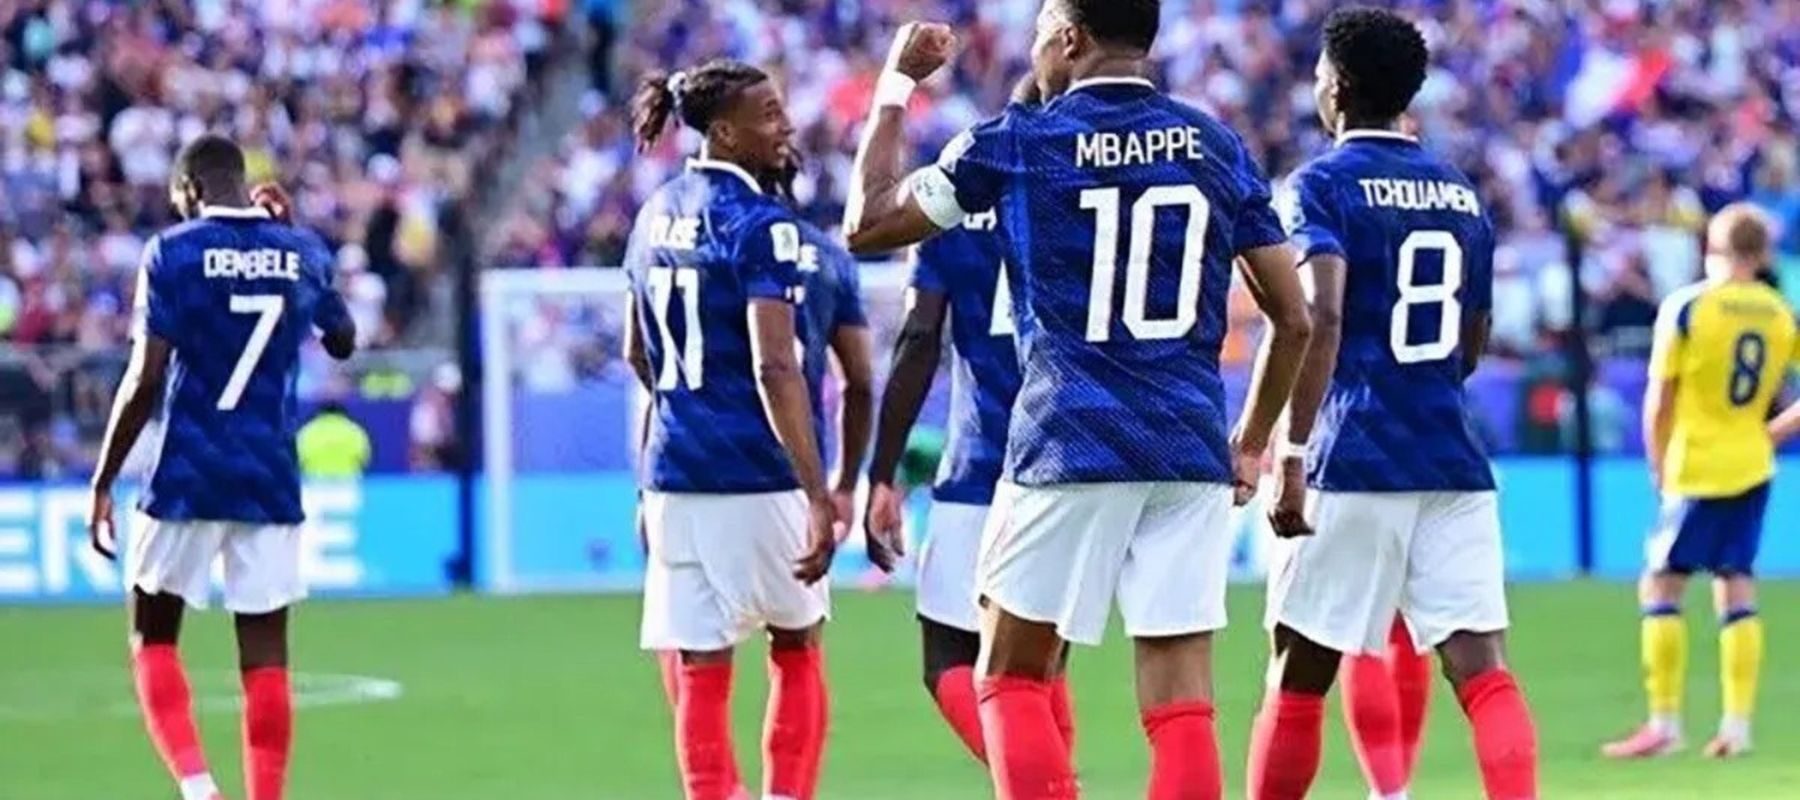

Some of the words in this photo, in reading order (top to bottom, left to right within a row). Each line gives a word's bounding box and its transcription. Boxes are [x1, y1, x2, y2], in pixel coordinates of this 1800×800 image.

[1076, 125, 1204, 168] MBAPPE
[1079, 184, 1210, 343] 10
[1390, 230, 1463, 364] 8
[217, 294, 284, 410] 7
[648, 266, 703, 391] 11
[1729, 332, 1765, 407] 8
